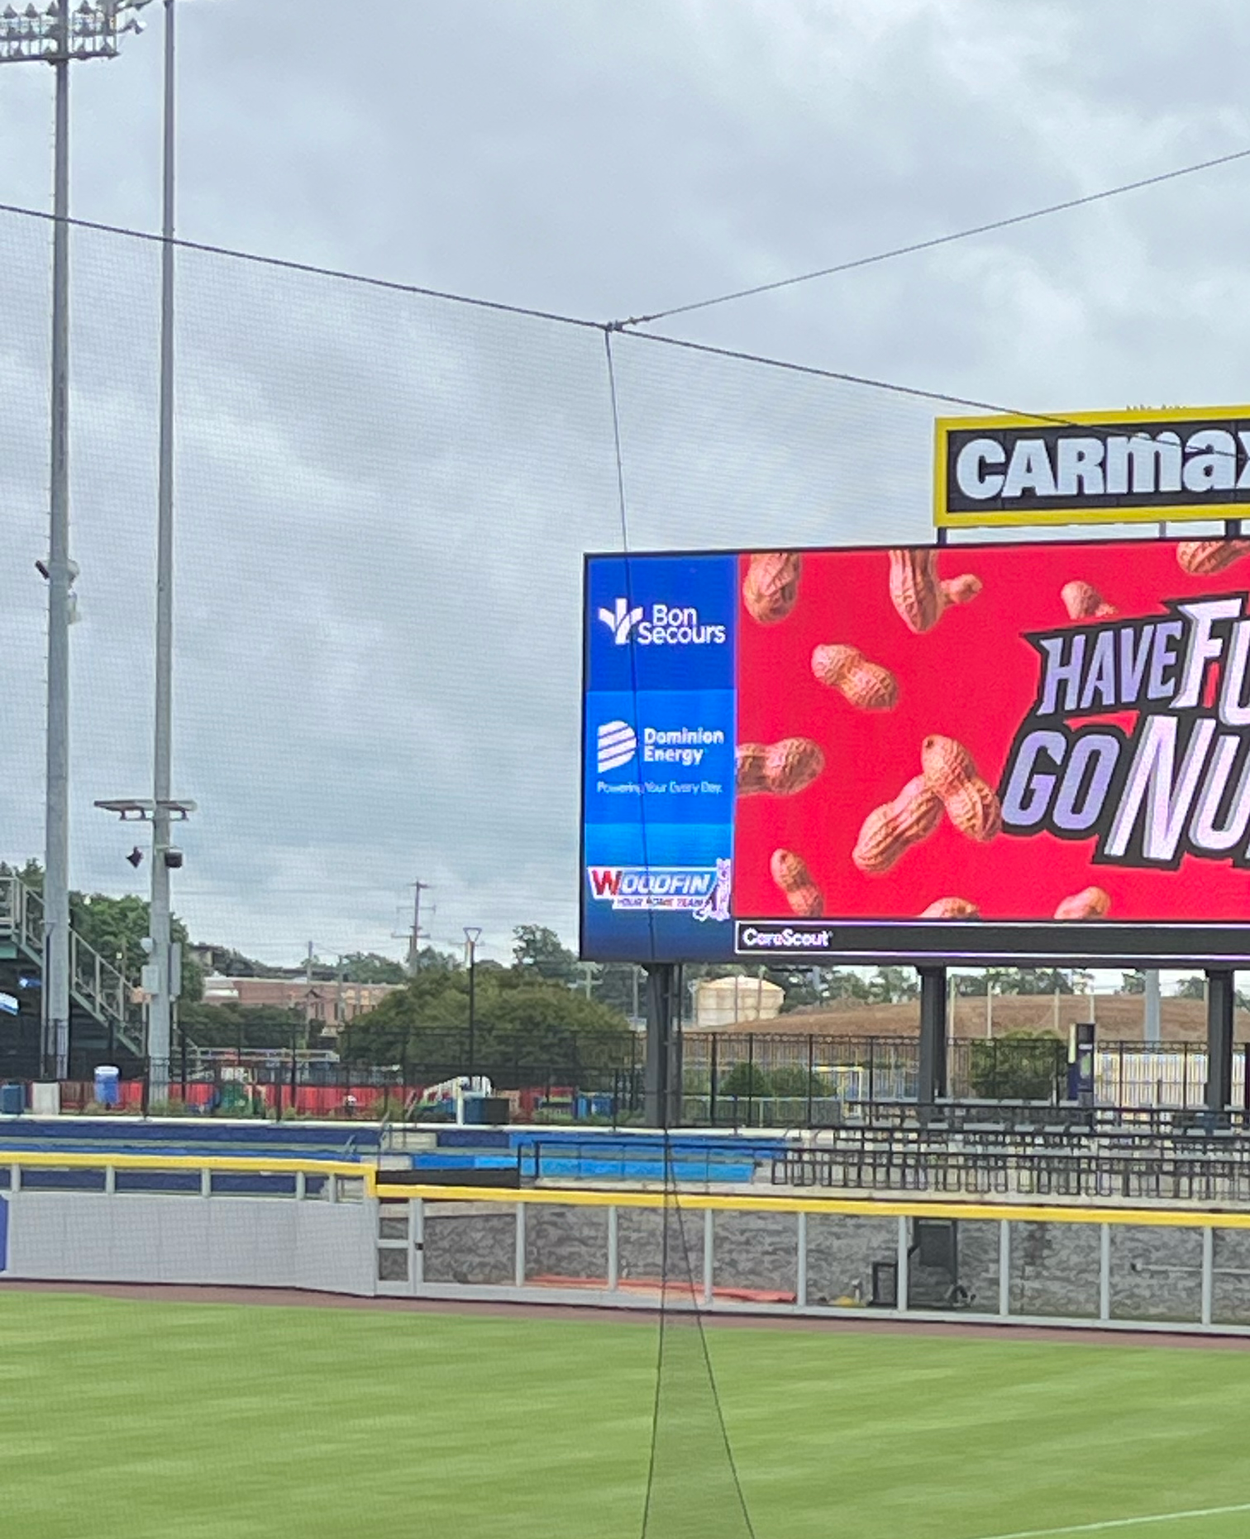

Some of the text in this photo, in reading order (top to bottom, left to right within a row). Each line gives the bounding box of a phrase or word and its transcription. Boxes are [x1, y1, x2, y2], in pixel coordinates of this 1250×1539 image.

[652, 604, 697, 626] Bon
[637, 622, 726, 645] Secours
[1037, 620, 1182, 715] HAVE
[644, 727, 725, 744] Dominion
[644, 745, 704, 765] Energy
[645, 781, 667, 793] Your
[669, 781, 700, 795] Every
[1002, 731, 1120, 830] GO
[592, 870, 710, 896] WOODFIN
[743, 928, 829, 946] CareScout
